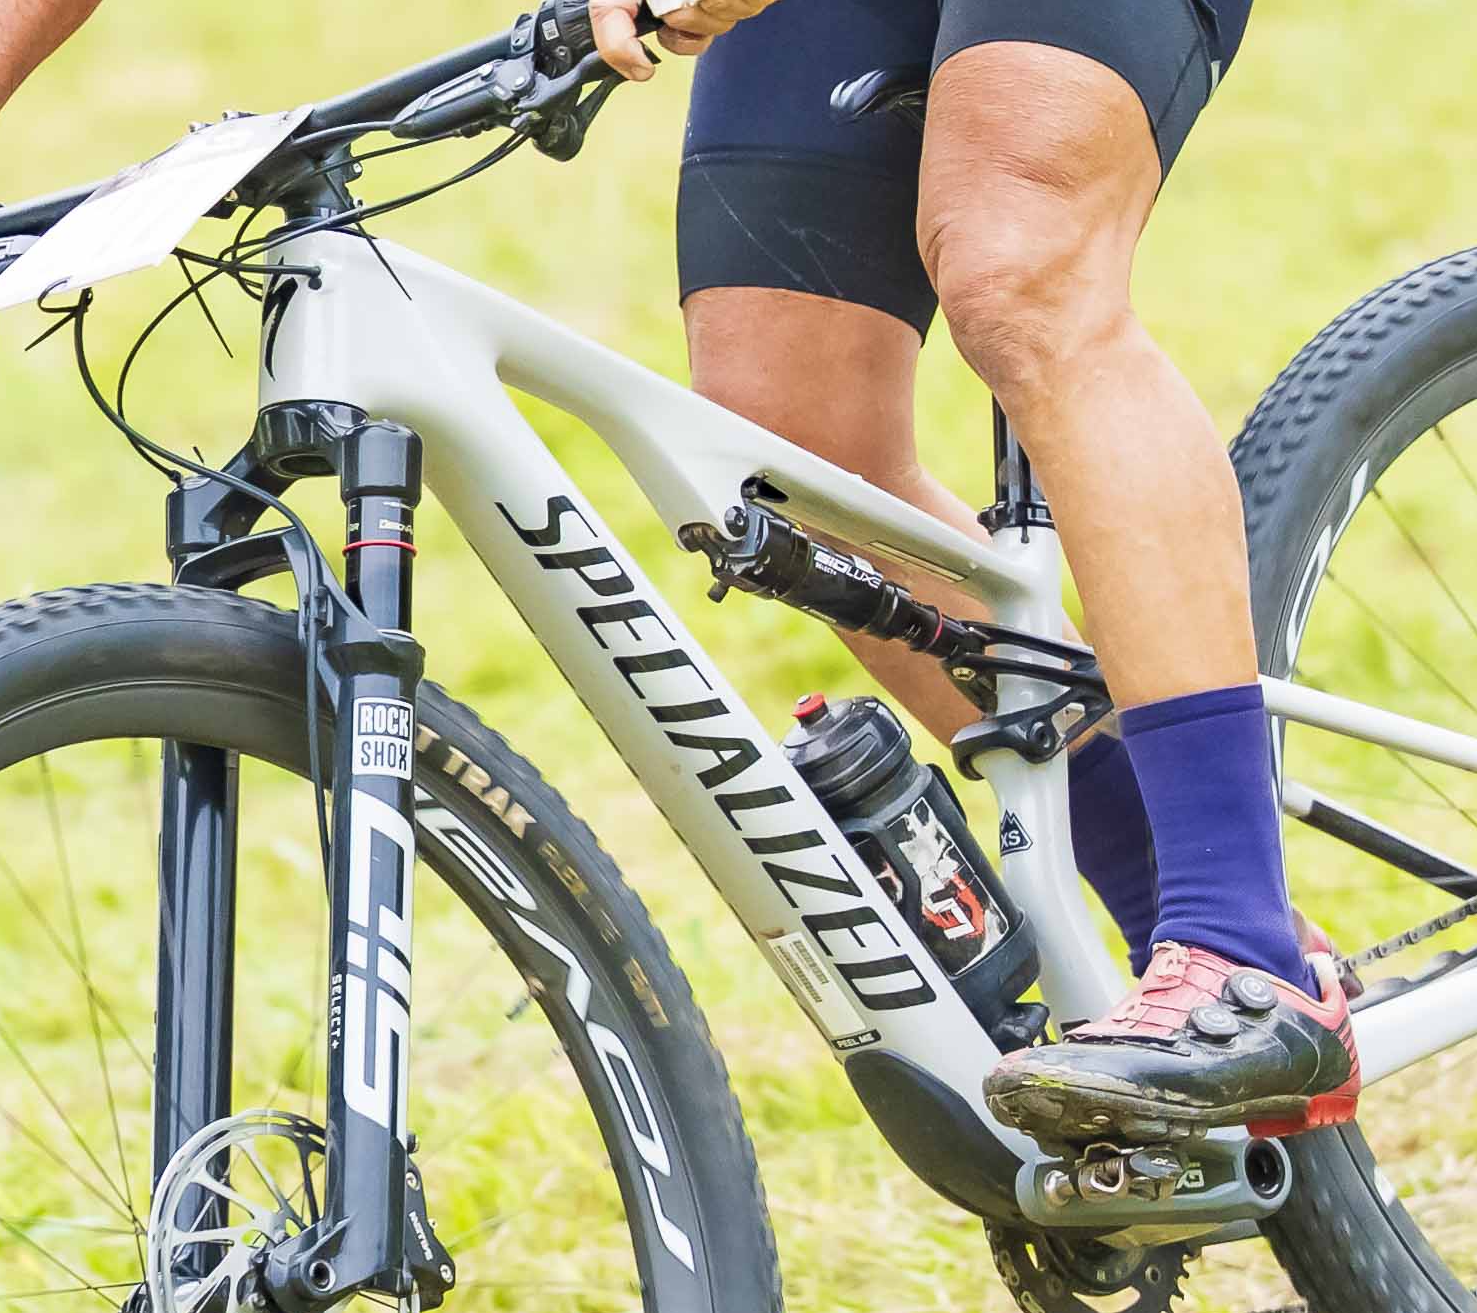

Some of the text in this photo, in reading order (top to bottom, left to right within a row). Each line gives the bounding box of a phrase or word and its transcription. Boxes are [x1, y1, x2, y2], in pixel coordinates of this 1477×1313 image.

[359, 704, 410, 739] ROCK
[361, 740, 407, 772] SHOX
[494, 495, 937, 1012] SPECIALIZED
[441, 746, 536, 840] TRAK
[330, 972, 343, 1050] SELECT+
